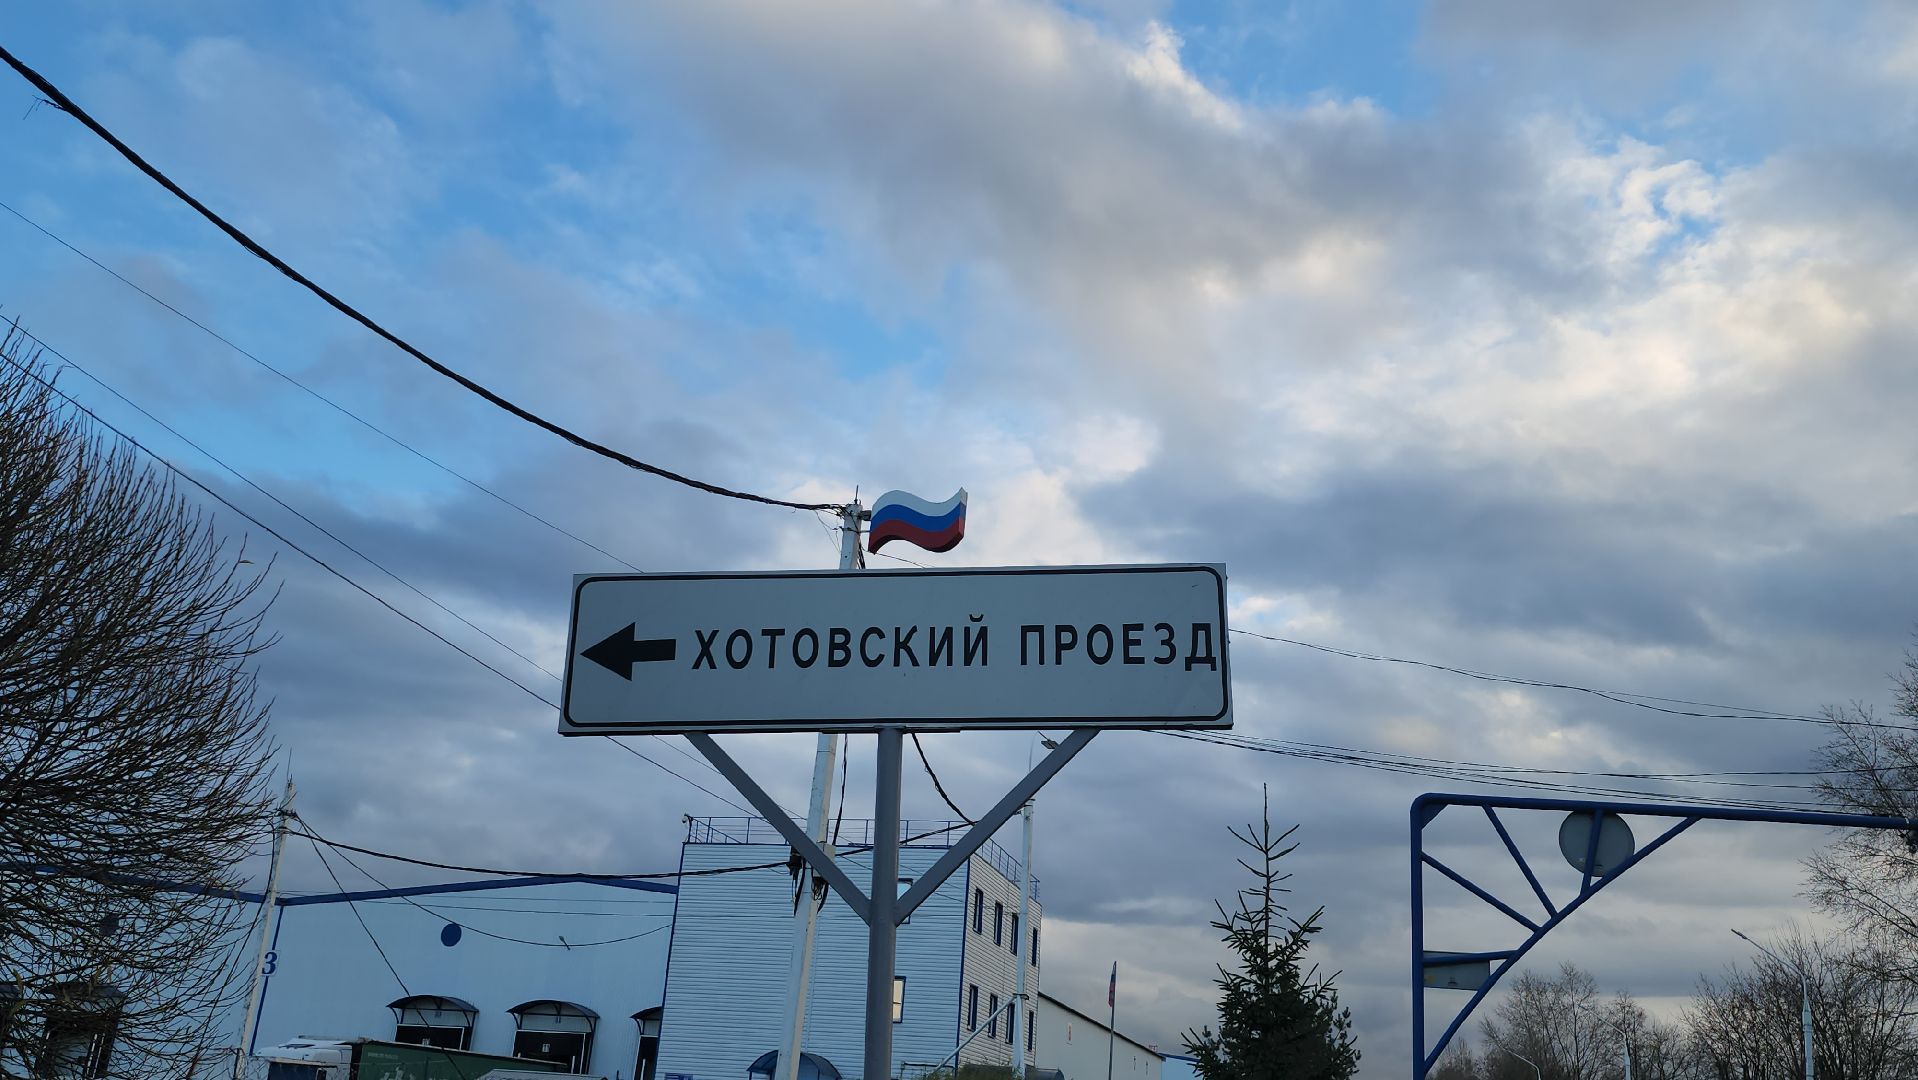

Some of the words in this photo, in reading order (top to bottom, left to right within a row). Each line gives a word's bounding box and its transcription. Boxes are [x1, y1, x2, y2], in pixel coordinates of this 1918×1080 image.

[690, 613, 989, 670] ХОТОВСКИЙ
[1020, 622, 1217, 672] ПРОЕЗД
[261, 951, 278, 975] 3
